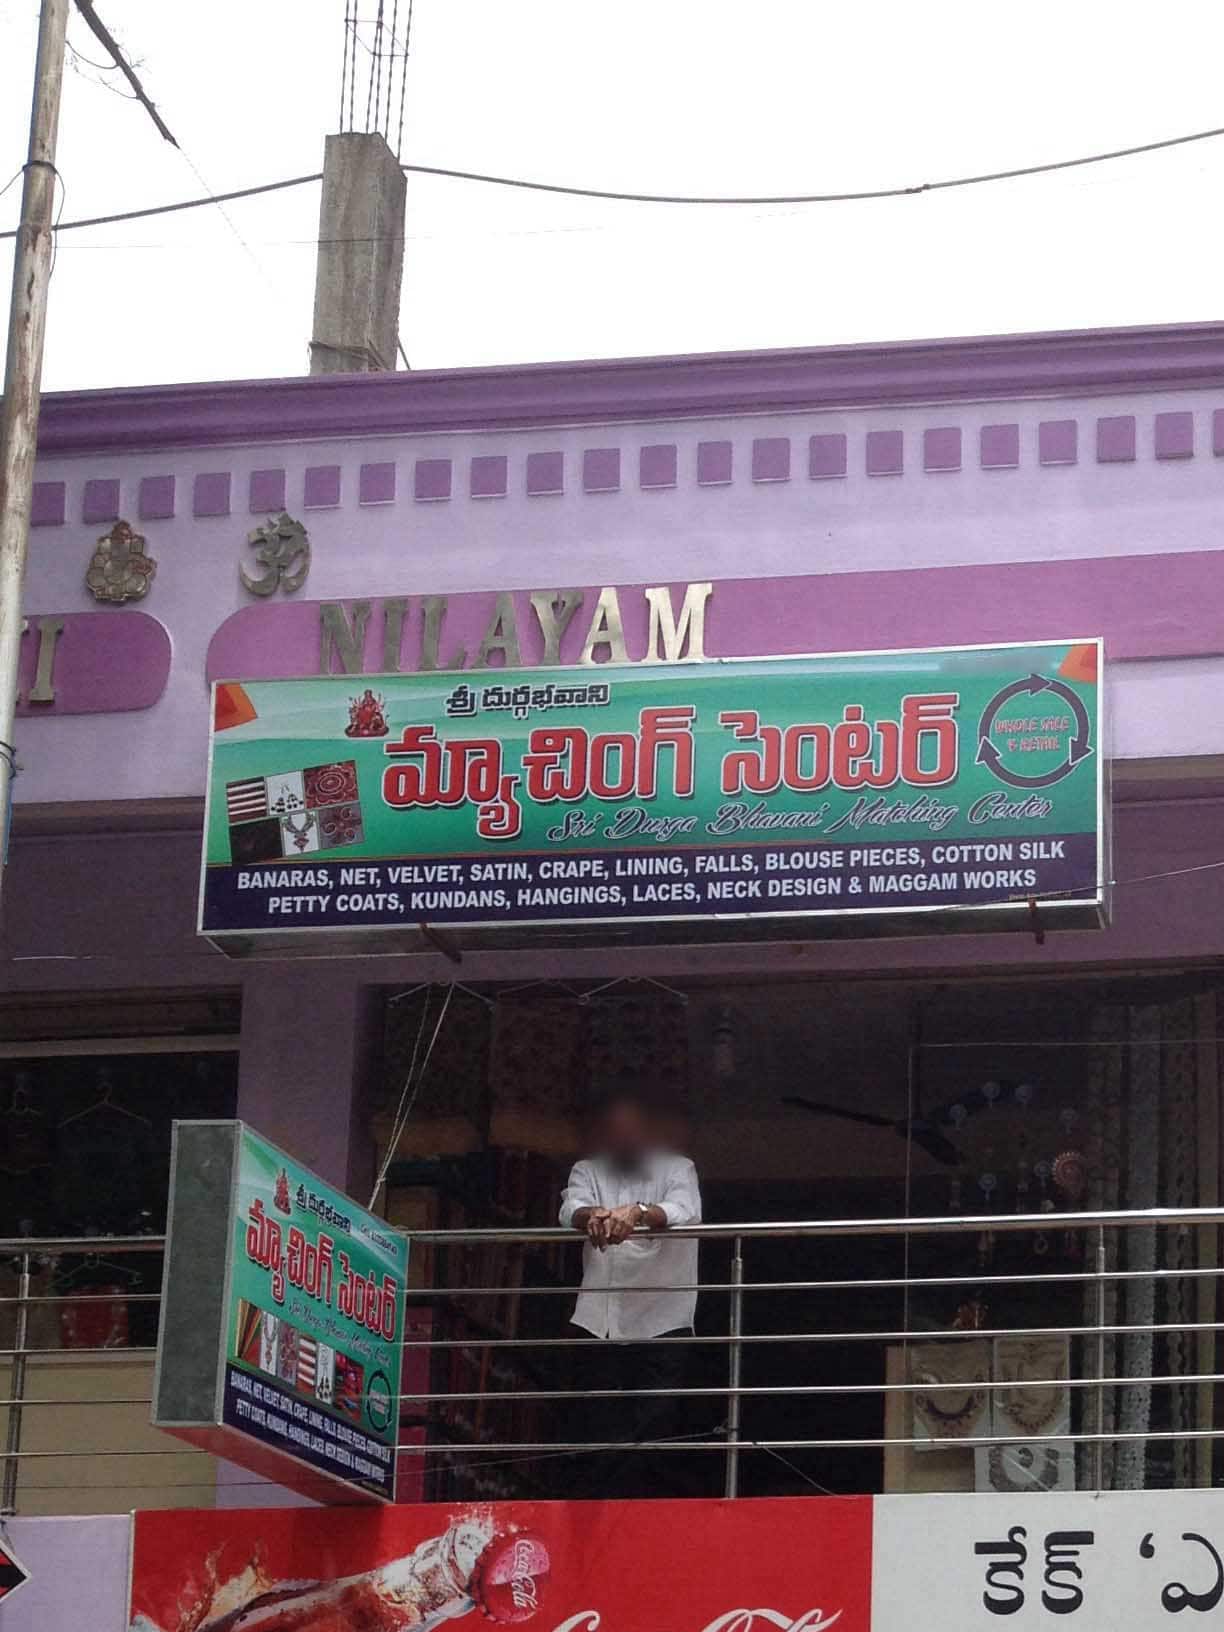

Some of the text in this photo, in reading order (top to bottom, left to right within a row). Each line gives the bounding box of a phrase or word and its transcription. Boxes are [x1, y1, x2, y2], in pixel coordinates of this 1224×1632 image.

[318, 581, 714, 676] NILAYAM
[383, 693, 959, 839] మ్యాచింగ్ సెంటర్
[550, 792, 1054, 841] Sri Durga Bhavani Matching Center
[237, 840, 1065, 890] BANARAS, NET, VELVET, SATIN, CRAPE, LINING, FALLS, BLOUSE PIECES, COTTON SILK
[268, 869, 1036, 915] PETTY COATS, KUNDANS, HANGINGS, LACES, NECK DESIGN & MAGGAM WORKS
[974, 1525, 1095, 1616] కేక్
